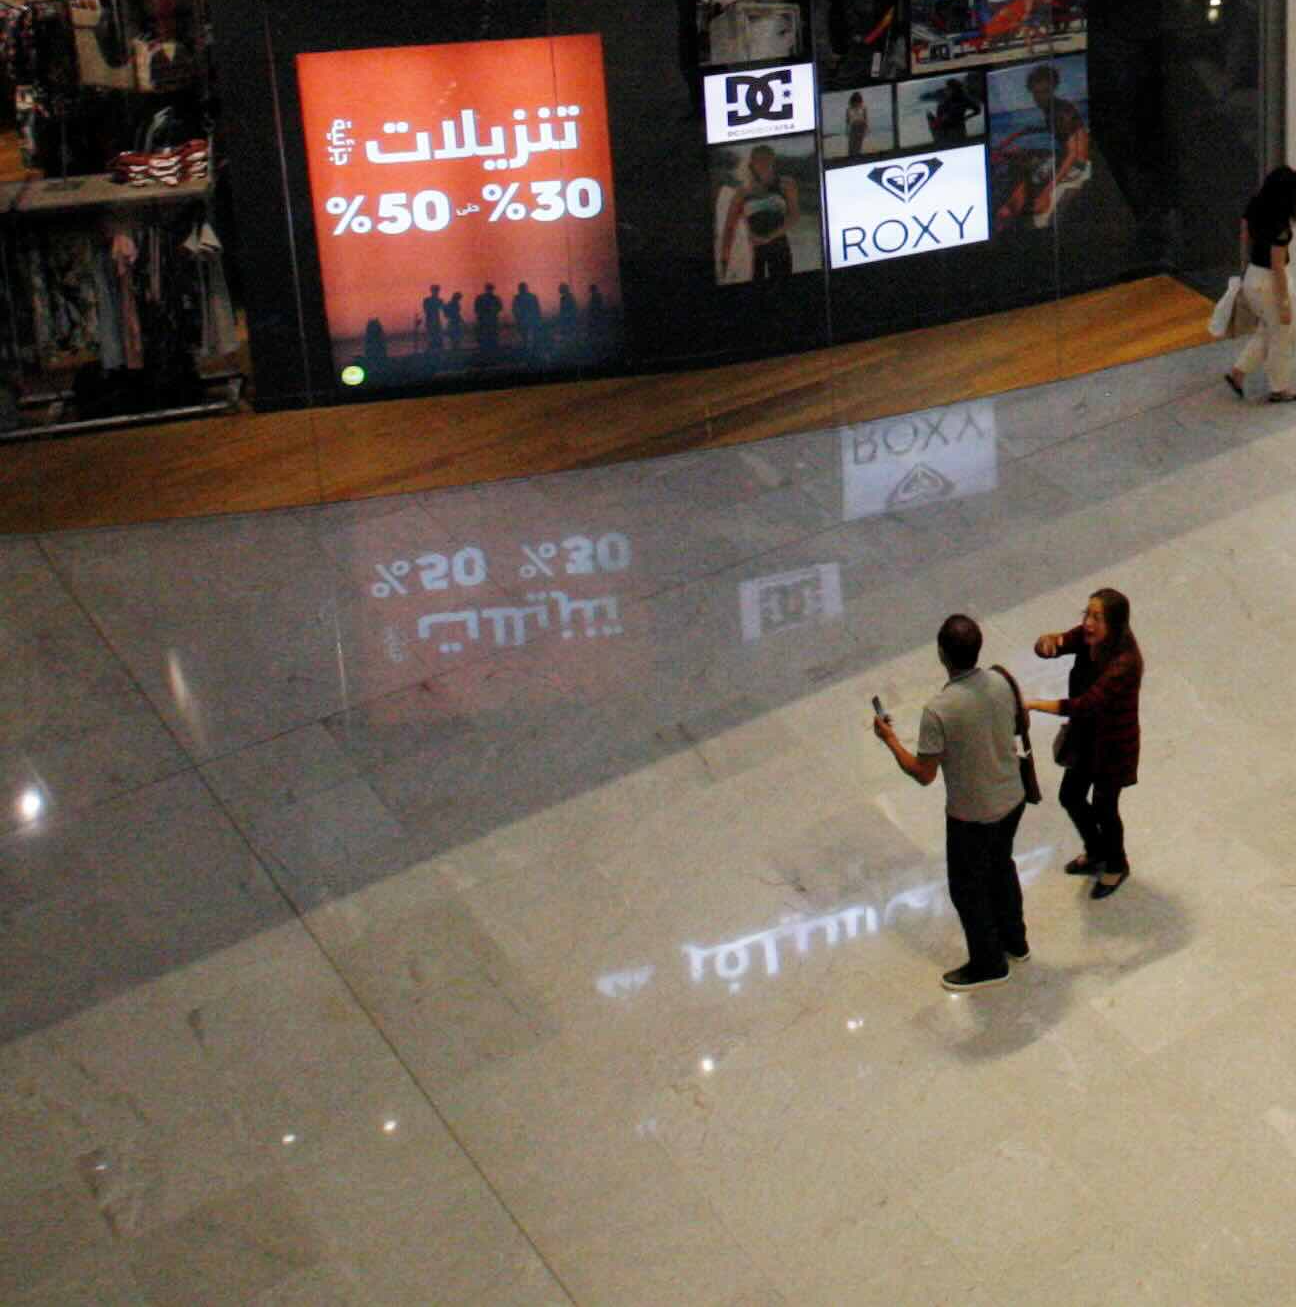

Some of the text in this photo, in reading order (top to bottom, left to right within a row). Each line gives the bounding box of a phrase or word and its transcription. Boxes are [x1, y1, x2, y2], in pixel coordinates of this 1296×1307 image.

[725, 69, 794, 127] DC
[364, 104, 581, 172] تنزيلات
[841, 204, 975, 262] ROXY
